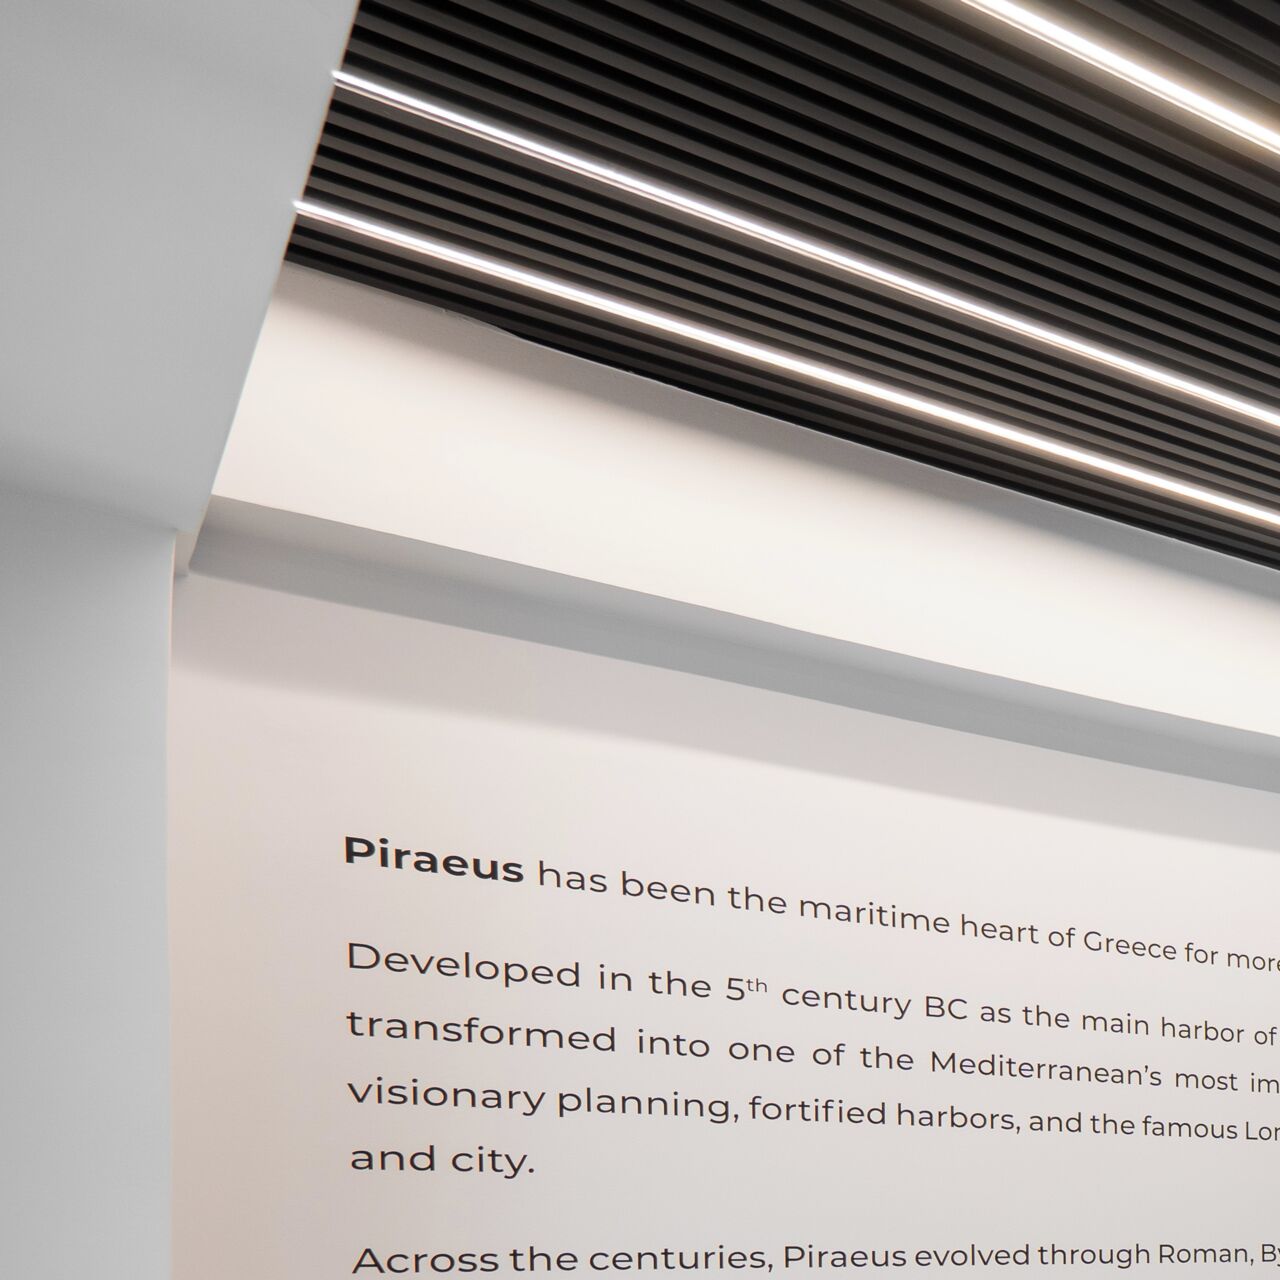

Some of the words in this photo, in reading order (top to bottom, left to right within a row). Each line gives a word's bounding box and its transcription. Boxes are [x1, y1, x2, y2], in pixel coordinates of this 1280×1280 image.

[344, 835, 525, 883] Piraeus
[538, 859, 608, 893] has
[621, 870, 715, 907] been
[727, 885, 788, 915] the
[799, 899, 951, 934] maritime
[961, 913, 1040, 945] heart
[1047, 926, 1077, 949] of
[1083, 930, 1178, 961] Greece
[1183, 941, 1219, 966] for
[348, 942, 580, 989] Developed
[599, 963, 633, 992] in
[647, 970, 712, 999] the
[781, 988, 913, 1021] century
[925, 995, 968, 1021] BC
[980, 1005, 1012, 1024] as
[1021, 1004, 1071, 1029] the
[1082, 1012, 1150, 1036] main
[1161, 1016, 1245, 1044] harbor
[1253, 1026, 1278, 1047] of
[345, 1011, 616, 1053] transformed
[637, 1028, 711, 1058] into
[728, 1041, 796, 1064] one
[812, 1042, 847, 1067] of
[859, 1045, 915, 1071] the
[1175, 1072, 1239, 1092] most
[346, 1075, 547, 1117] visionary
[558, 1086, 739, 1125] planning,
[748, 1095, 886, 1125] fortified
[897, 1102, 1021, 1135] harbors,
[1028, 1111, 1082, 1133] and
[1089, 1112, 1136, 1136] the
[1141, 1114, 1239, 1140] famous
[350, 1144, 436, 1172] and
[451, 1145, 535, 1180] city.
[351, 1247, 500, 1275] Across
[508, 1245, 579, 1272] the
[589, 1244, 774, 1273] centuries,
[784, 1243, 907, 1269] Piraeus
[914, 1243, 1030, 1267] evolved
[1037, 1242, 1151, 1270] through
[1159, 1243, 1255, 1267] Roman,
